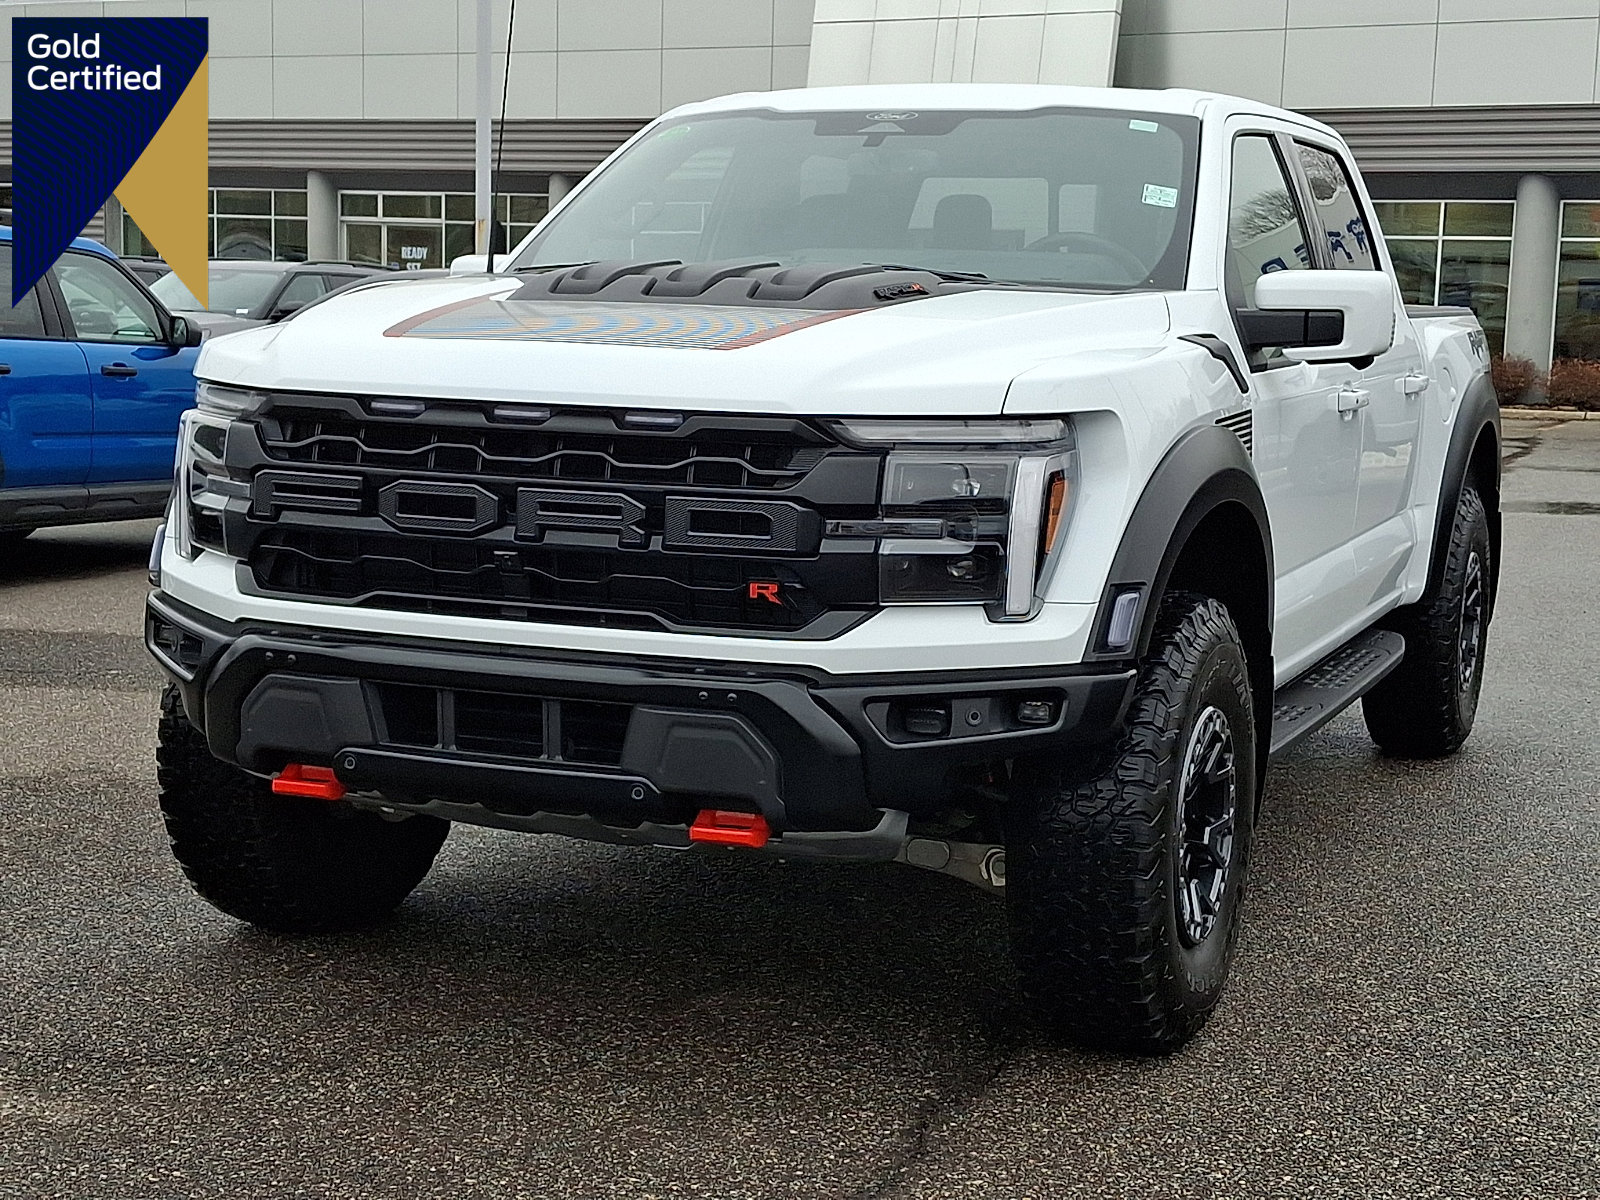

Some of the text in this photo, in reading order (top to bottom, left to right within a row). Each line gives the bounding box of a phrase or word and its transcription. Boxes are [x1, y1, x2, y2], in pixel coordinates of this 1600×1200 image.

[401, 246, 428, 260] READY
[251, 469, 810, 555] FORD
[749, 582, 783, 605] R
